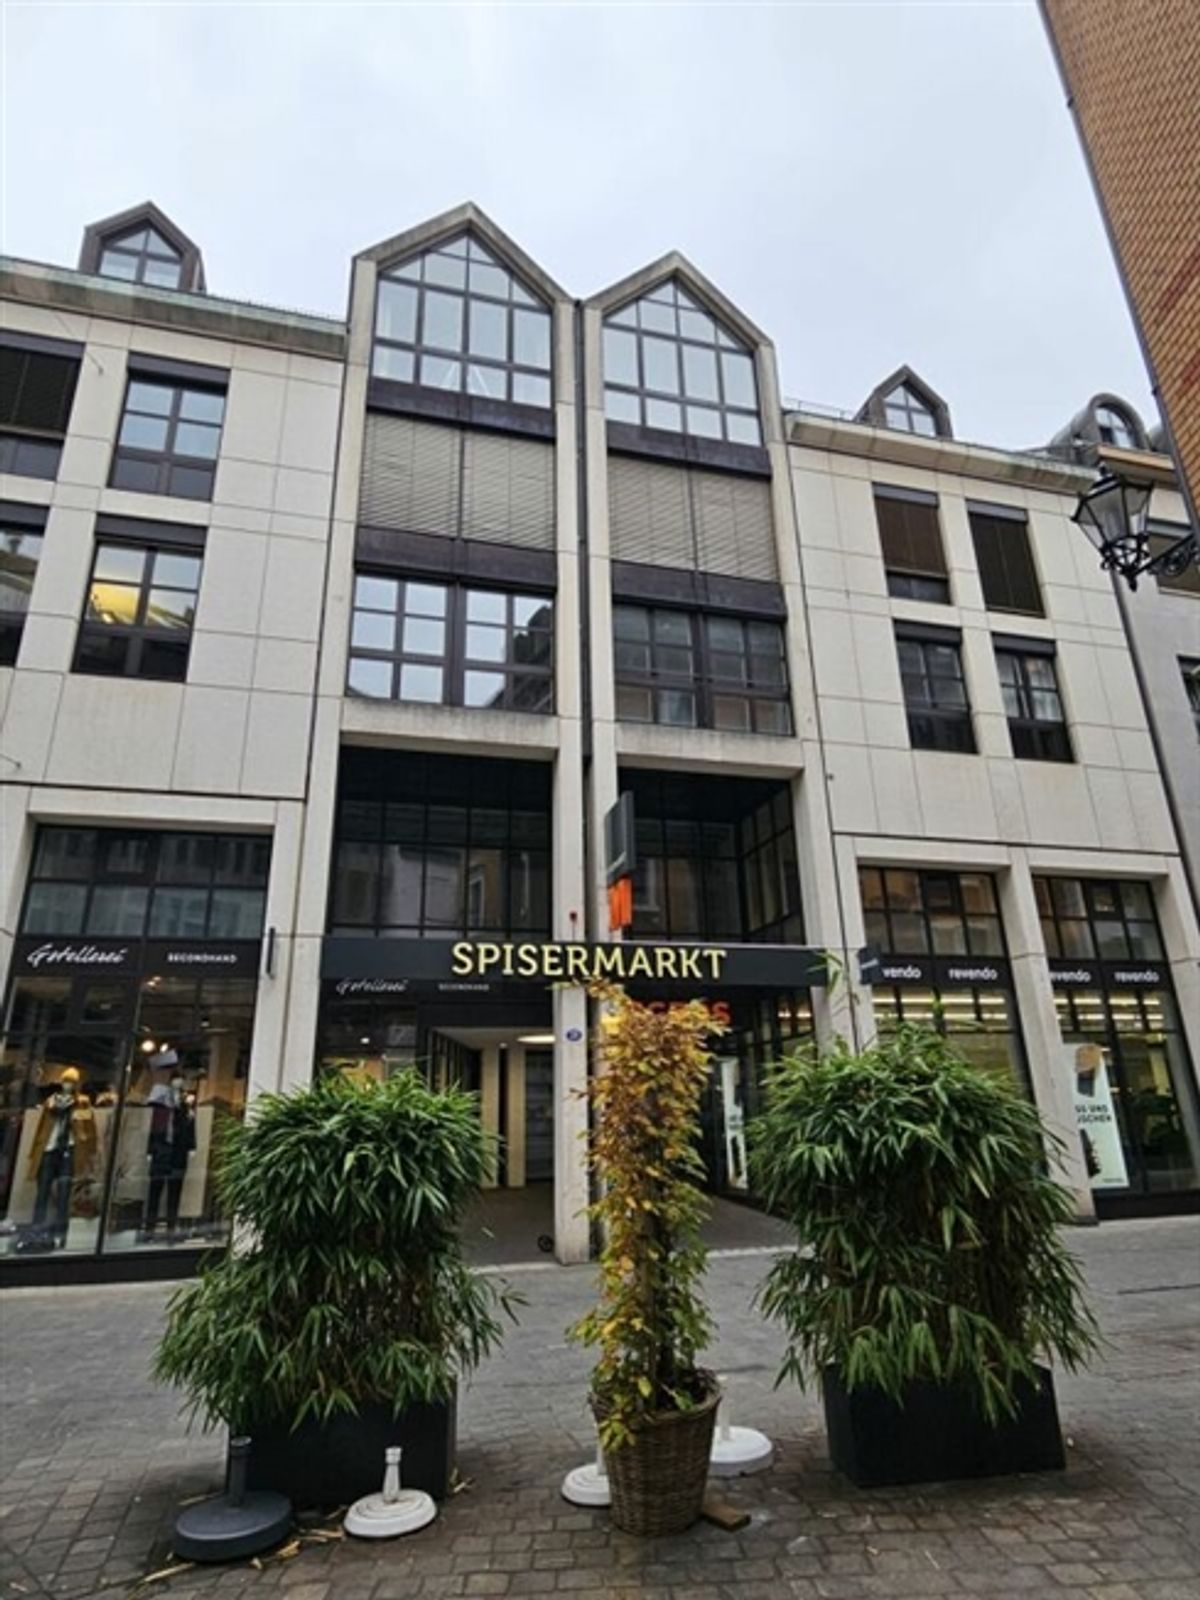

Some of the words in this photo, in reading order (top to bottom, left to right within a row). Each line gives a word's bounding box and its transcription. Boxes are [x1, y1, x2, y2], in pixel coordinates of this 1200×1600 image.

[167, 952, 238, 963] SECONDHAND
[451, 942, 727, 978] SPISERMARKT
[949, 967, 998, 980] revendo
[1114, 969, 1160, 982] revendo
